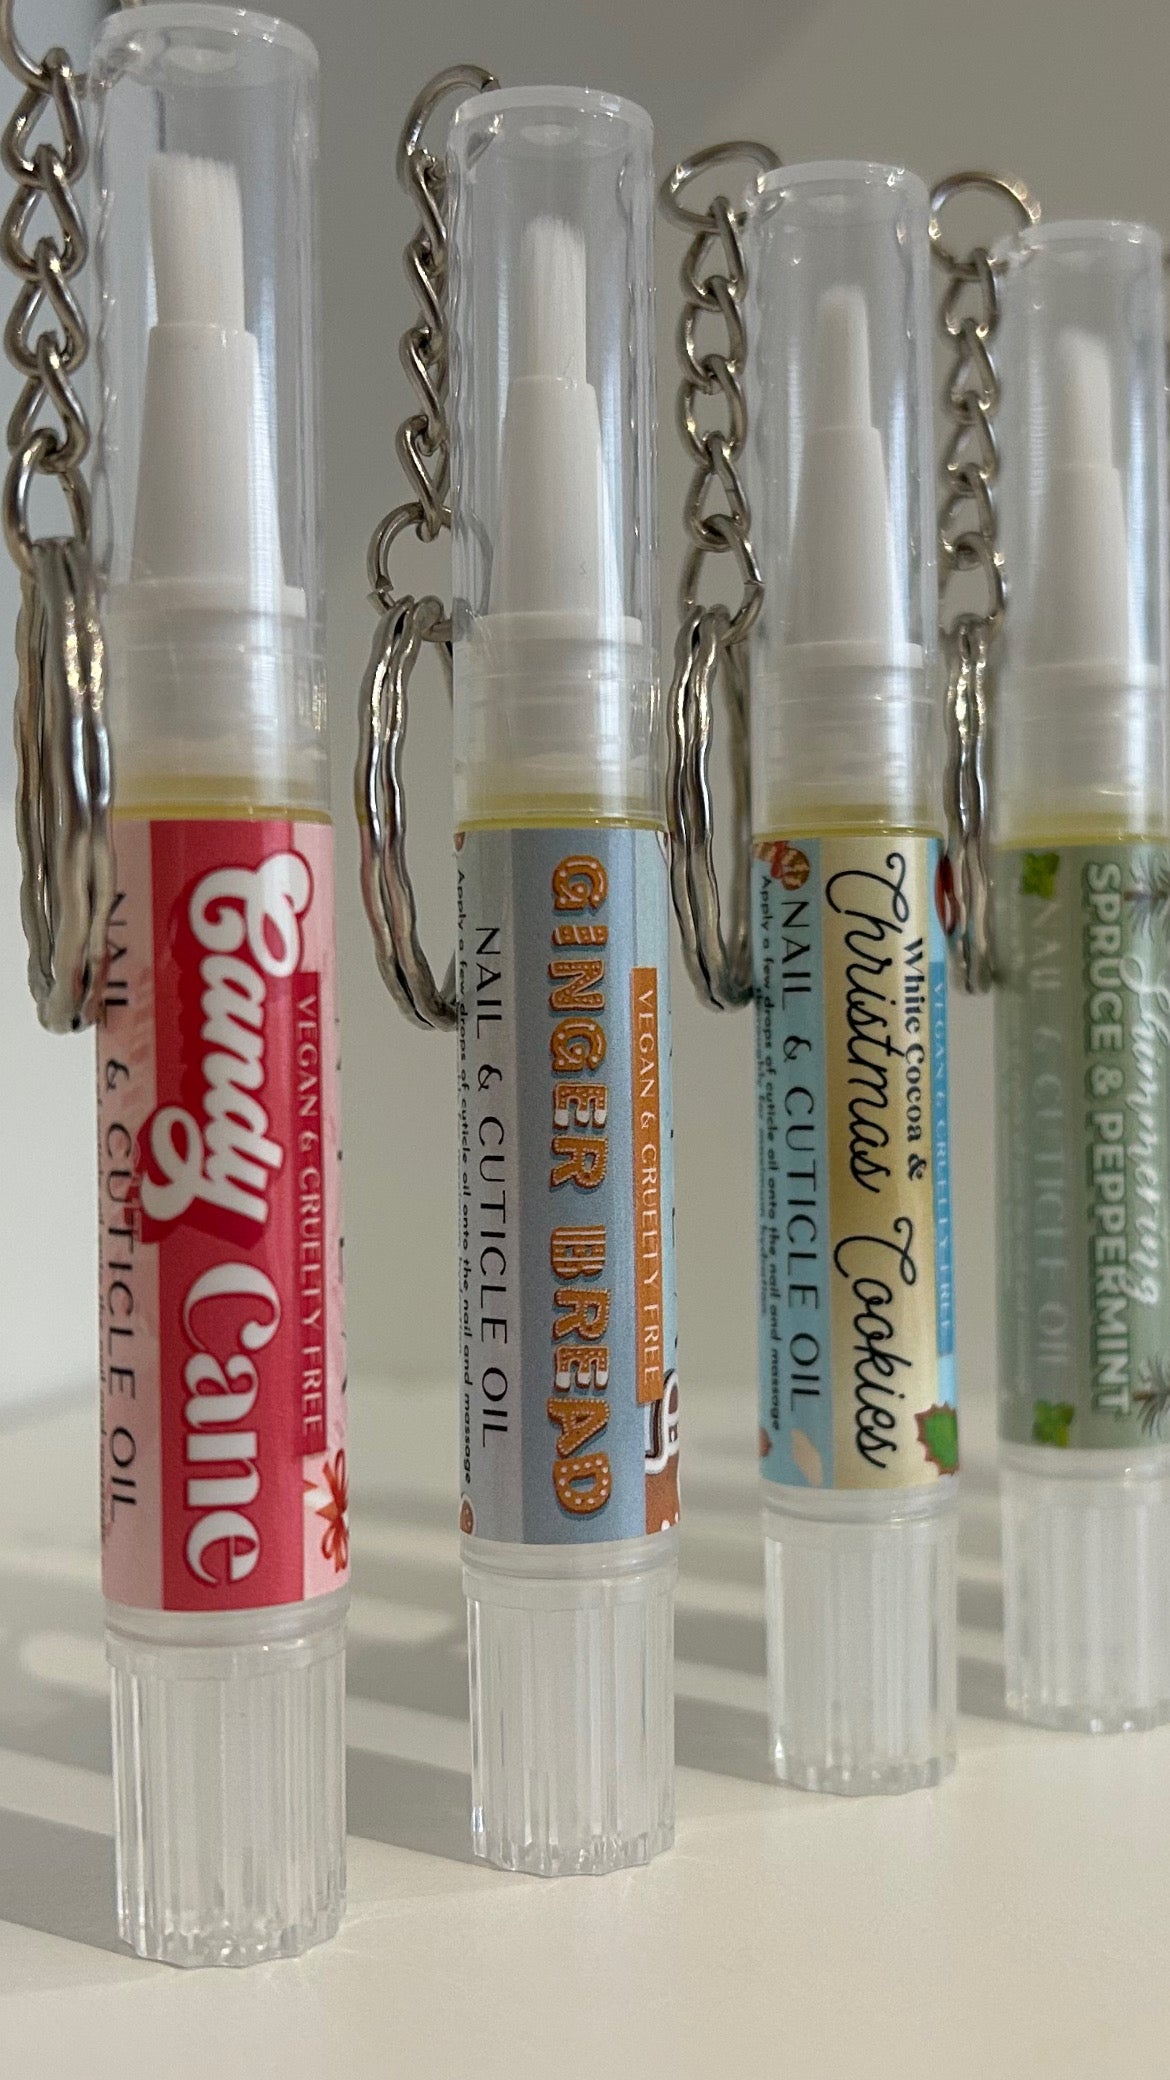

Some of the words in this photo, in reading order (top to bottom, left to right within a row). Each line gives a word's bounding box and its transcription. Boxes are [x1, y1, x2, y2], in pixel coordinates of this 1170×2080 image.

[457, 869, 467, 930] Apply
[761, 875, 773, 931] Apply
[105, 892, 129, 1028] NAIL
[459, 960, 469, 996] few
[476, 927, 503, 1040] NAIL
[781, 900, 812, 1010] NAIL
[903, 937, 926, 1034] White
[1088, 863, 1123, 1051] SPRUCE
[140, 852, 310, 1222] Candy
[297, 995, 318, 1117] VEGAN
[458, 1002, 469, 1062] drops
[549, 854, 609, 1188] GINGER
[638, 989, 655, 1098] VEGAN
[782, 1034, 812, 1063] &
[825, 852, 909, 1193] Christmas
[105, 1059, 130, 1091] &
[460, 1068, 470, 1090] of
[477, 1063, 503, 1092] &
[640, 1111, 657, 1130] &
[903, 1042, 926, 1142] Cocoa
[1089, 1064, 1124, 1097] &
[301, 1132, 319, 1153] &
[460, 1098, 471, 1165] cuticle
[908, 1153, 928, 1181] &
[1119, 956, 1170, 1305] Shimmering
[462, 1172, 471, 1196] oil
[462, 1203, 471, 1251] onto
[478, 1116, 509, 1344] CUTICLE
[641, 1143, 659, 1287] CRUELTY
[784, 1086, 819, 1309] CUTICLE
[105, 1123, 136, 1399] CUTICLE
[299, 1167, 322, 1328] CRUELTY
[463, 1258, 472, 1291] the
[1093, 1111, 1130, 1413] PEPPERMINT
[463, 1298, 473, 1338] nail
[643, 1303, 660, 1386] FREE
[834, 1216, 917, 1469] Cookies
[301, 1346, 322, 1435] FREE
[464, 1344, 474, 1386] and
[481, 1366, 509, 1448] OIL
[547, 1225, 612, 1515] BREAD
[789, 1332, 821, 1411] OIL
[183, 1262, 281, 1584] Cane
[463, 1393, 473, 1485] massage
[109, 1426, 137, 1520] OIL
